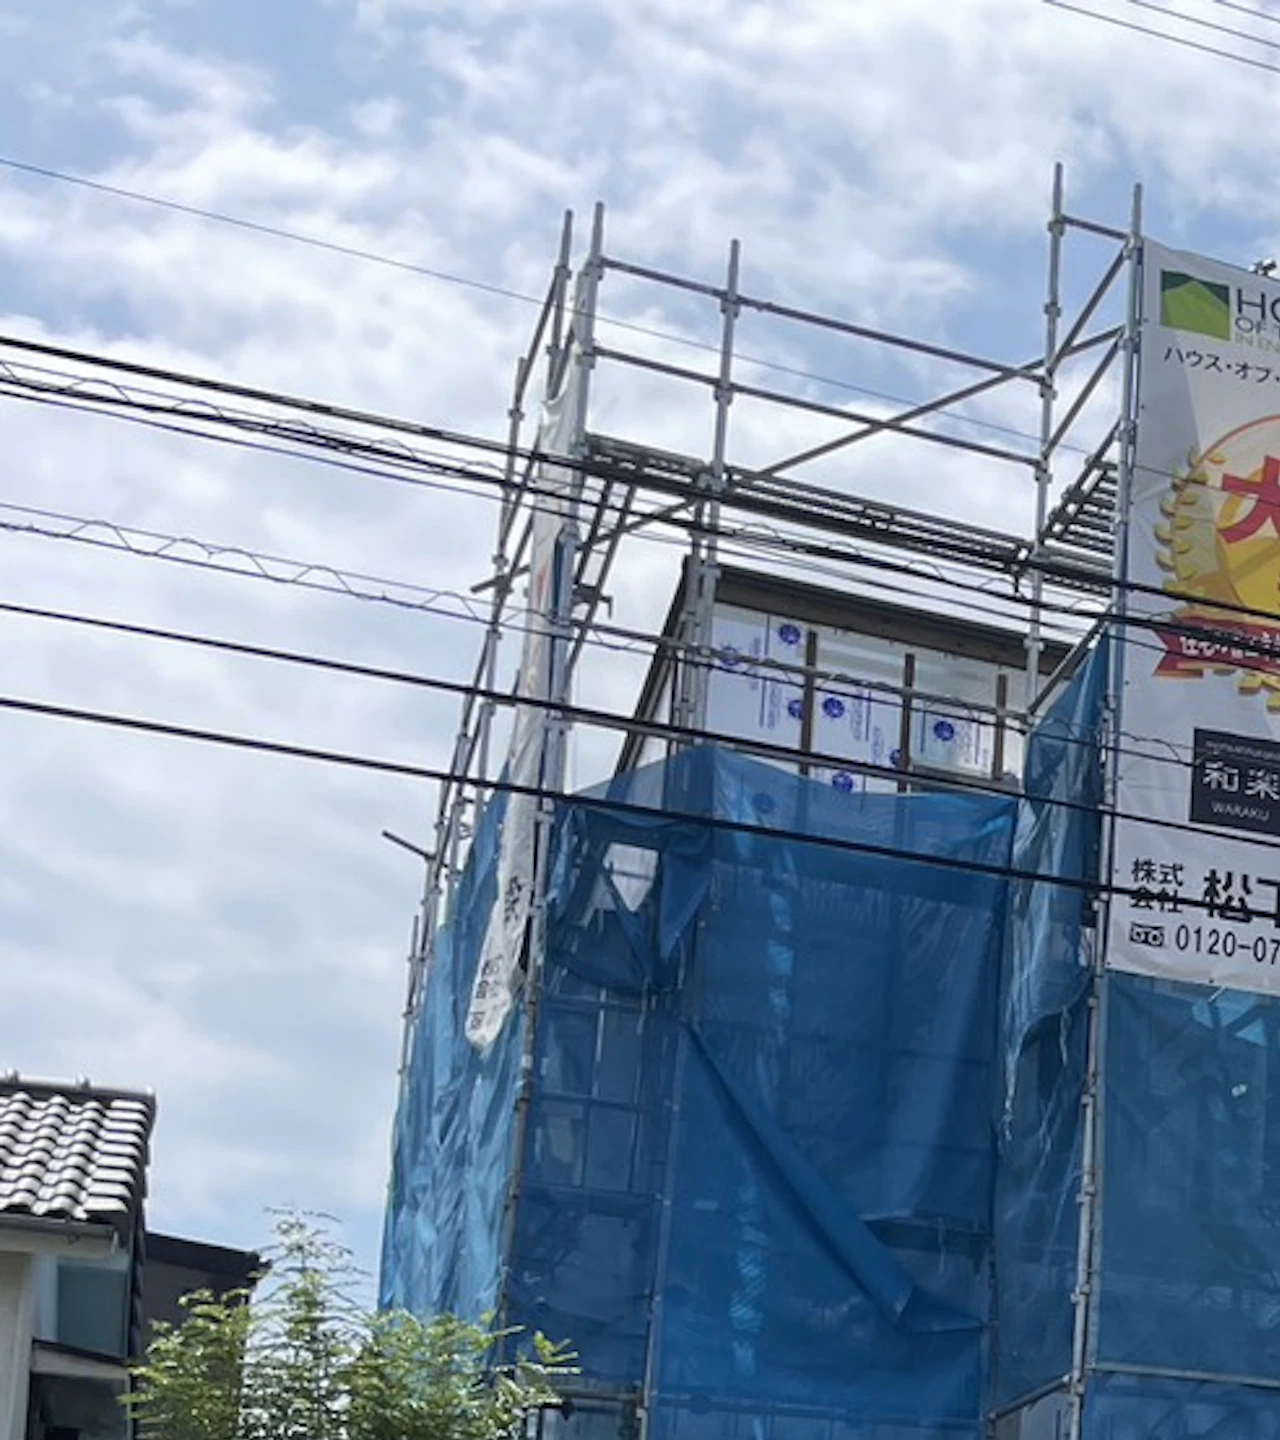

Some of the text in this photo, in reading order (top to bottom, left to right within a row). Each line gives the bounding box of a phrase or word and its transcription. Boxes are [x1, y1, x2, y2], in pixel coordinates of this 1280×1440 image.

[1235, 317, 1267, 334] OF
[1131, 857, 1184, 887] 株式
[1130, 886, 1184, 914] 会社
